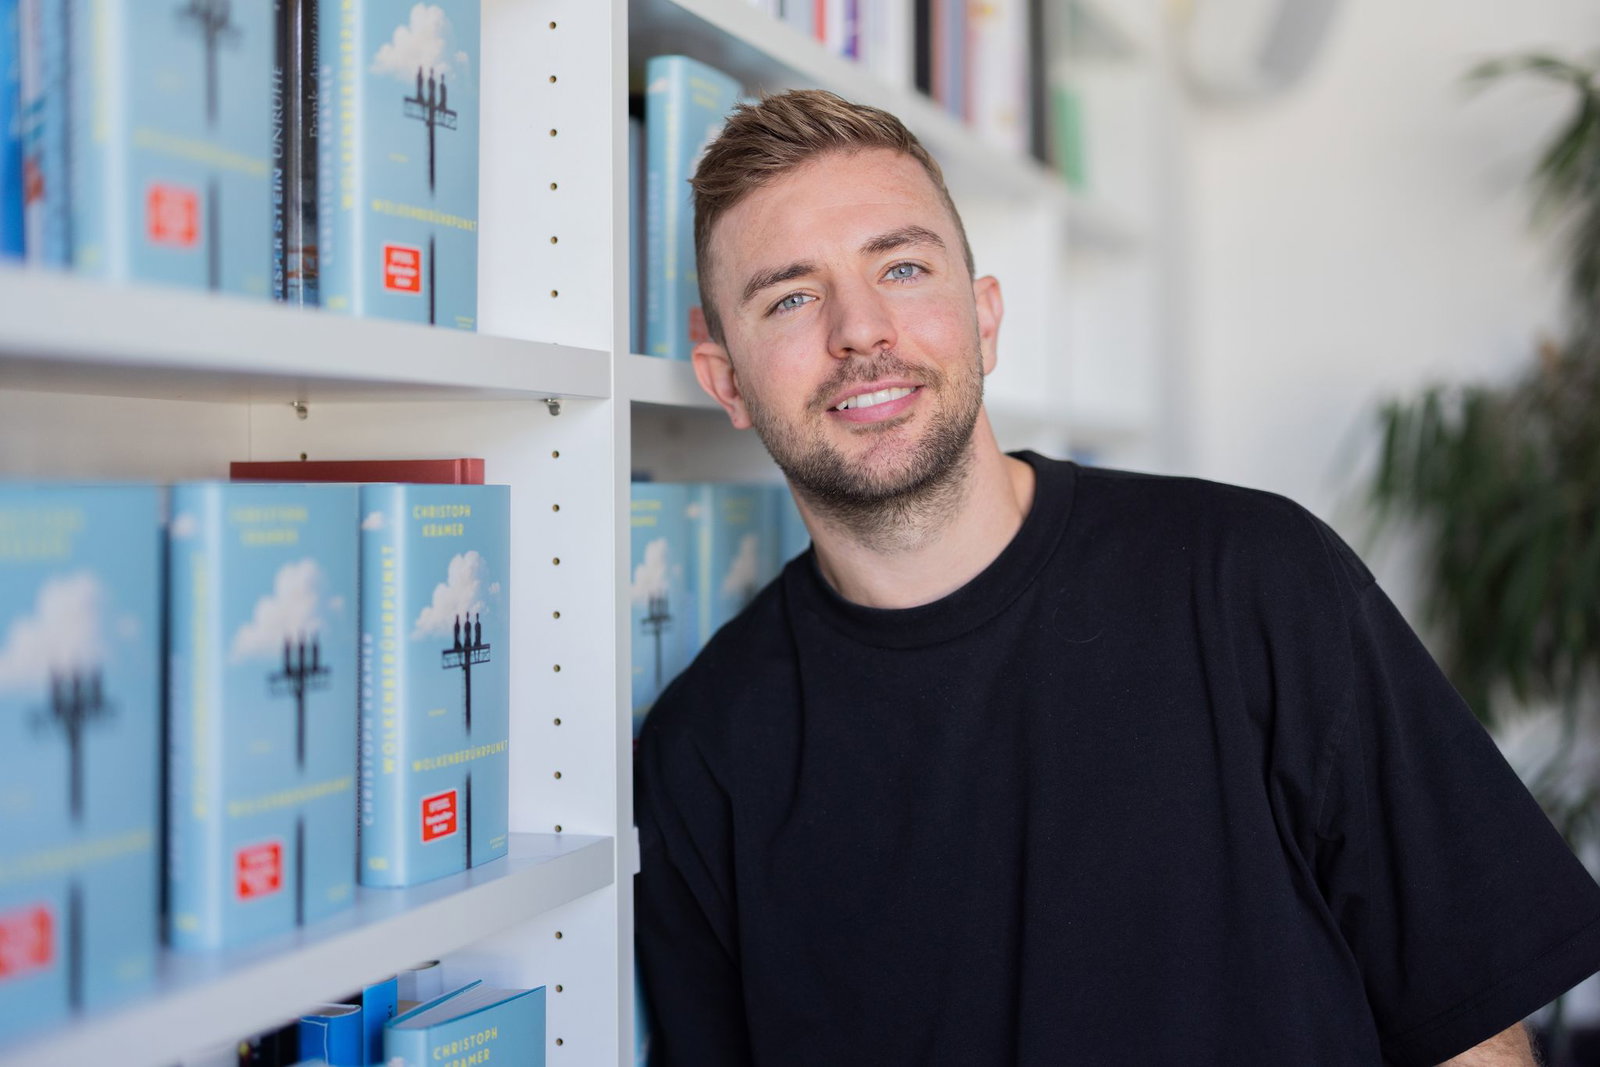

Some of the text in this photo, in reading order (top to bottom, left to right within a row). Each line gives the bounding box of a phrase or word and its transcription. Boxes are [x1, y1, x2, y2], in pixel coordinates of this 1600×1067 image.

[272, 65, 283, 159] UNRUHE
[272, 167, 283, 232] STEIN
[412, 504, 471, 520] CHRISTOPH
[422, 522, 464, 537] KRAMER
[432, 1026, 498, 1060] CHRISTOPH
